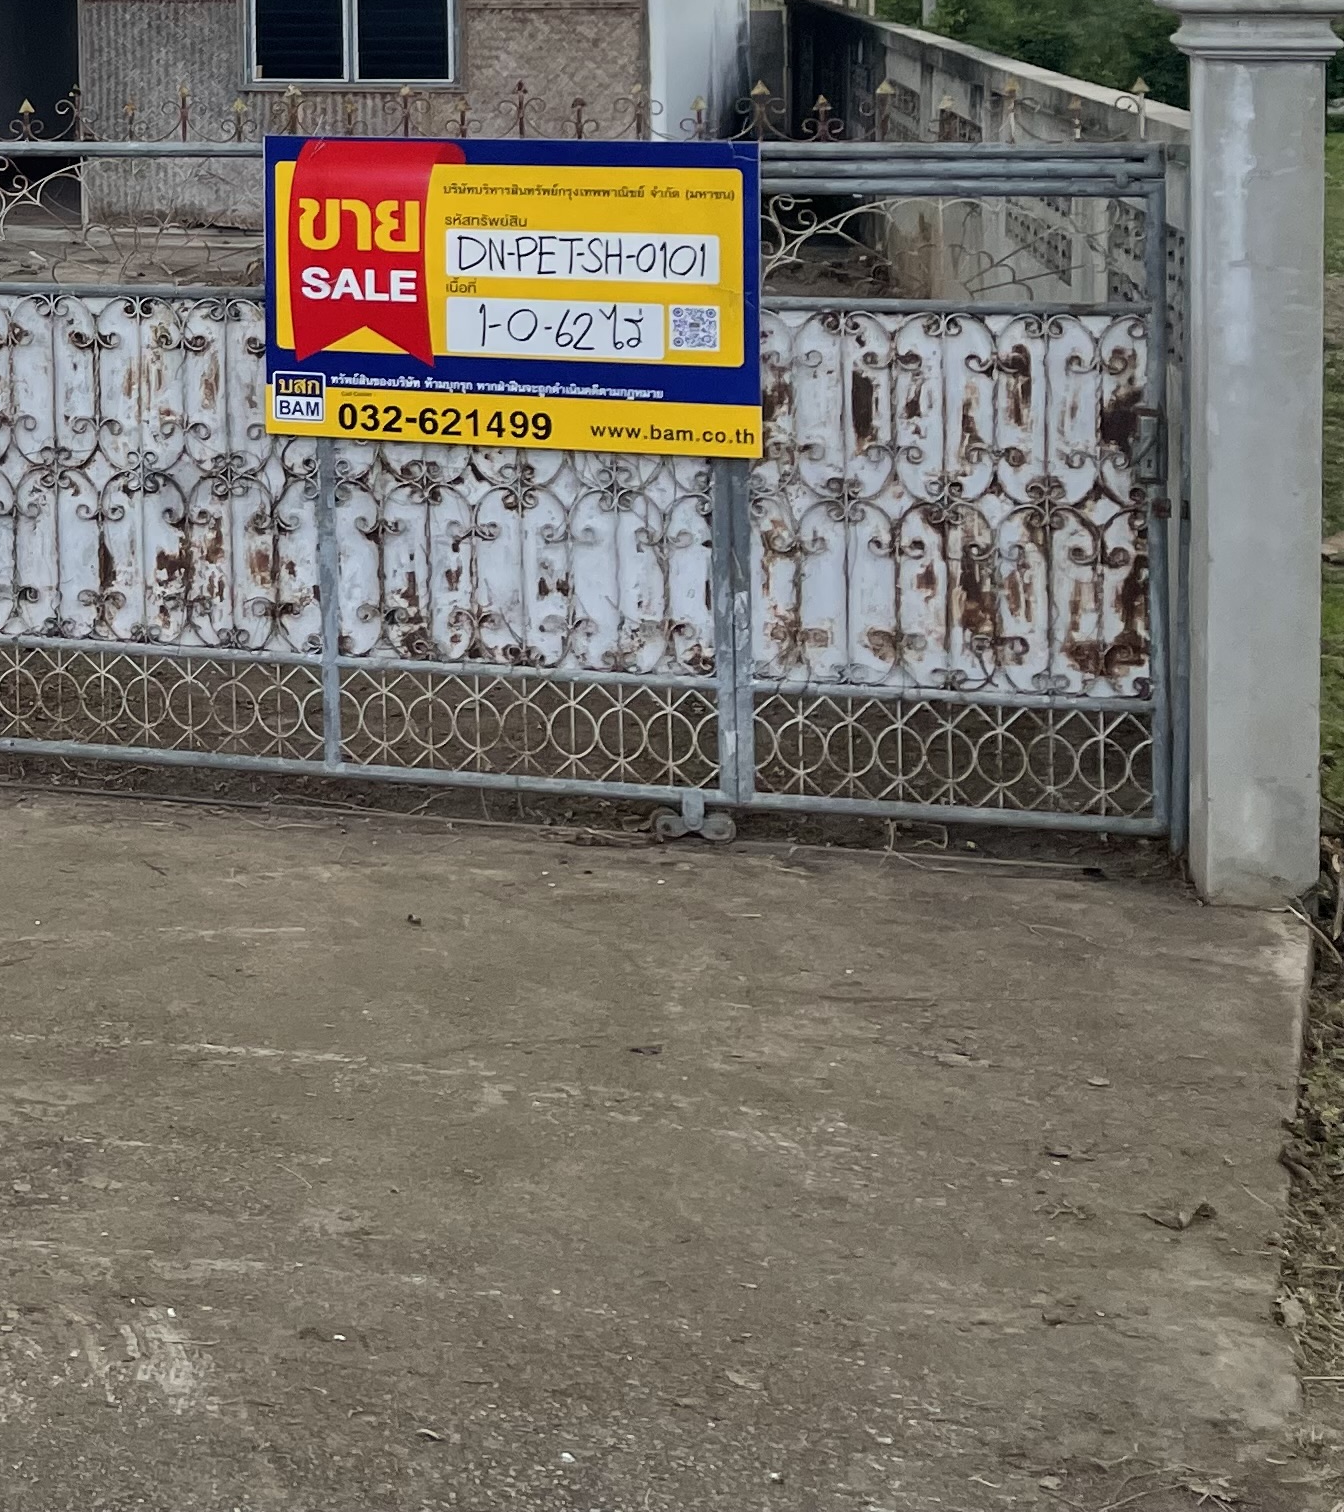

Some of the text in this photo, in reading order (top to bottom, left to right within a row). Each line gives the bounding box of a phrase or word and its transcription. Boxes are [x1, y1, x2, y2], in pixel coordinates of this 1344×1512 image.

[650, 185, 680, 198] จำกัด
[299, 198, 420, 252] ขาย
[302, 266, 417, 302] SALE
[446, 277, 477, 294] เนื้อที่
[278, 378, 320, 395] บสก
[279, 400, 320, 417] BAM
[338, 403, 552, 441] 032-621499
[590, 424, 755, 445] www.bam.co.th
